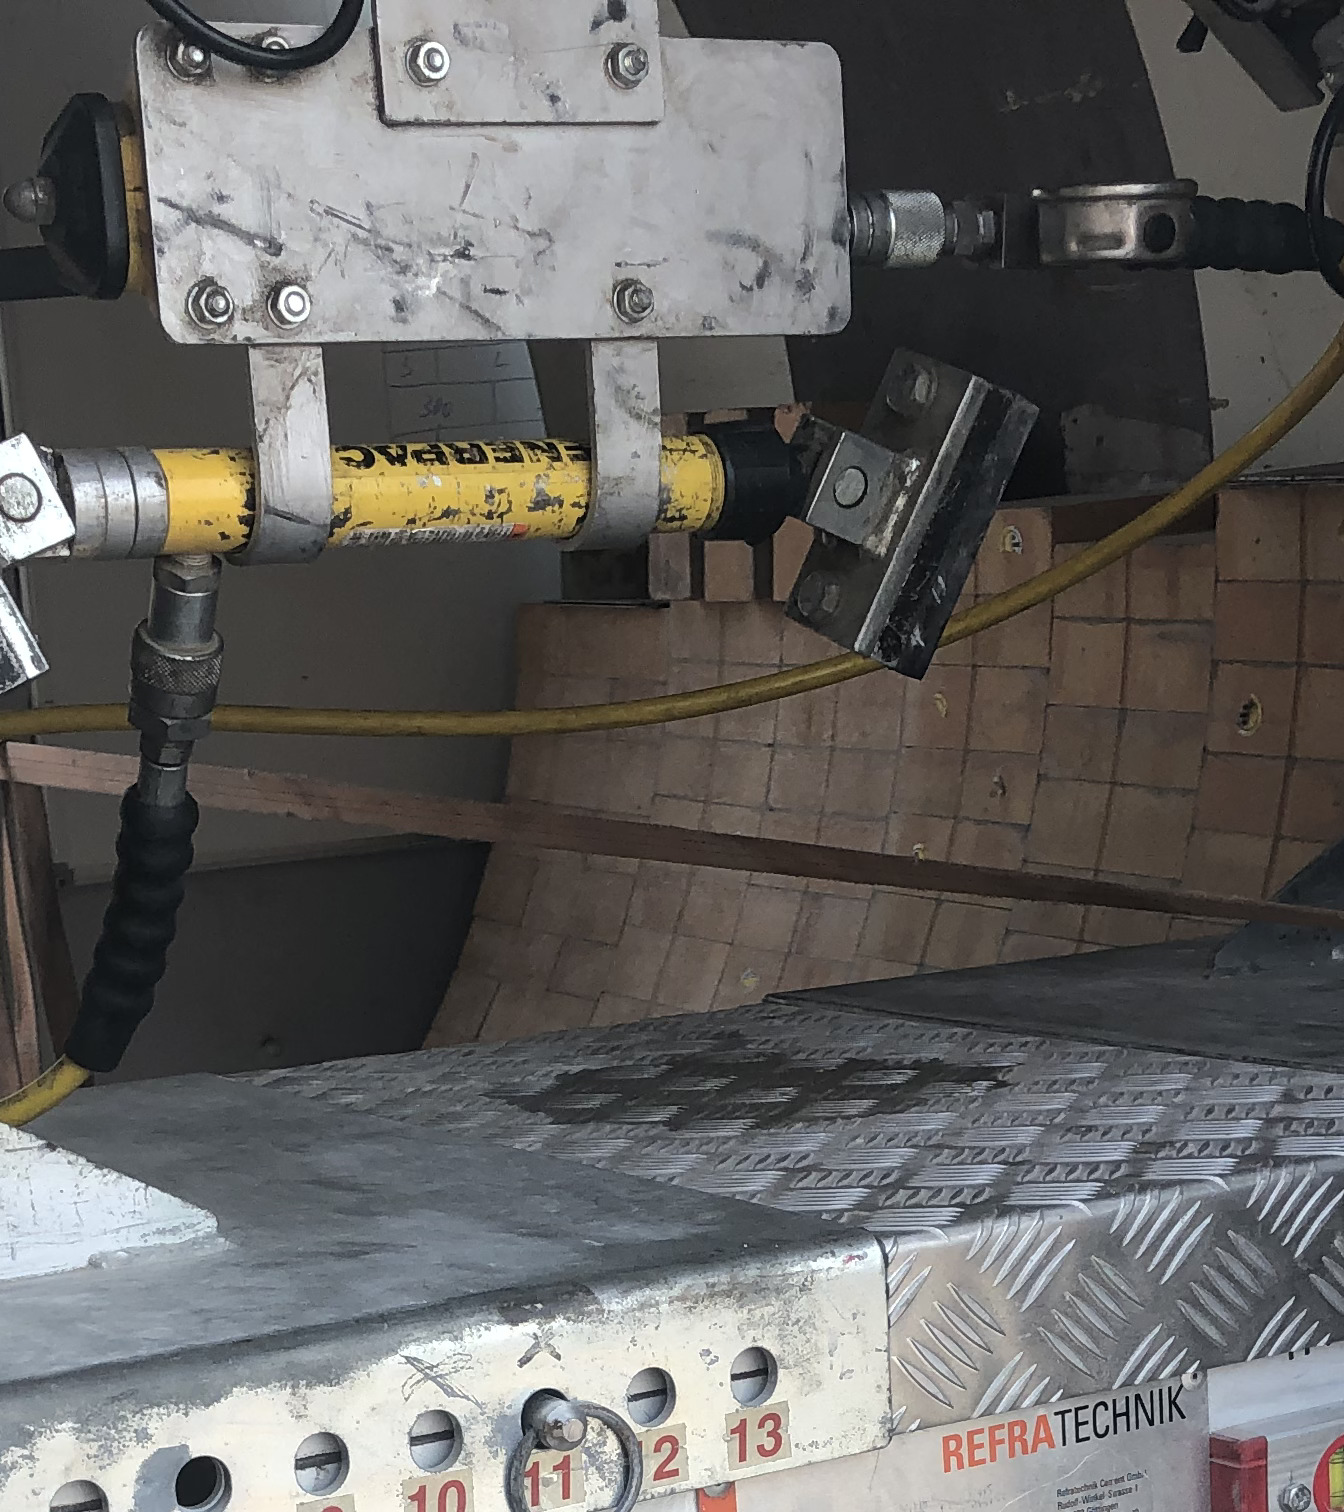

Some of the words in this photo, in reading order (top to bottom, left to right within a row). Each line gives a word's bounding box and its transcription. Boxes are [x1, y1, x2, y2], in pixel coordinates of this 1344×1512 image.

[730, 1412, 784, 1464] 13
[942, 1383, 1187, 1474] REFRATECHNIK
[523, 1454, 572, 1507] 11
[638, 1433, 681, 1482] 2
